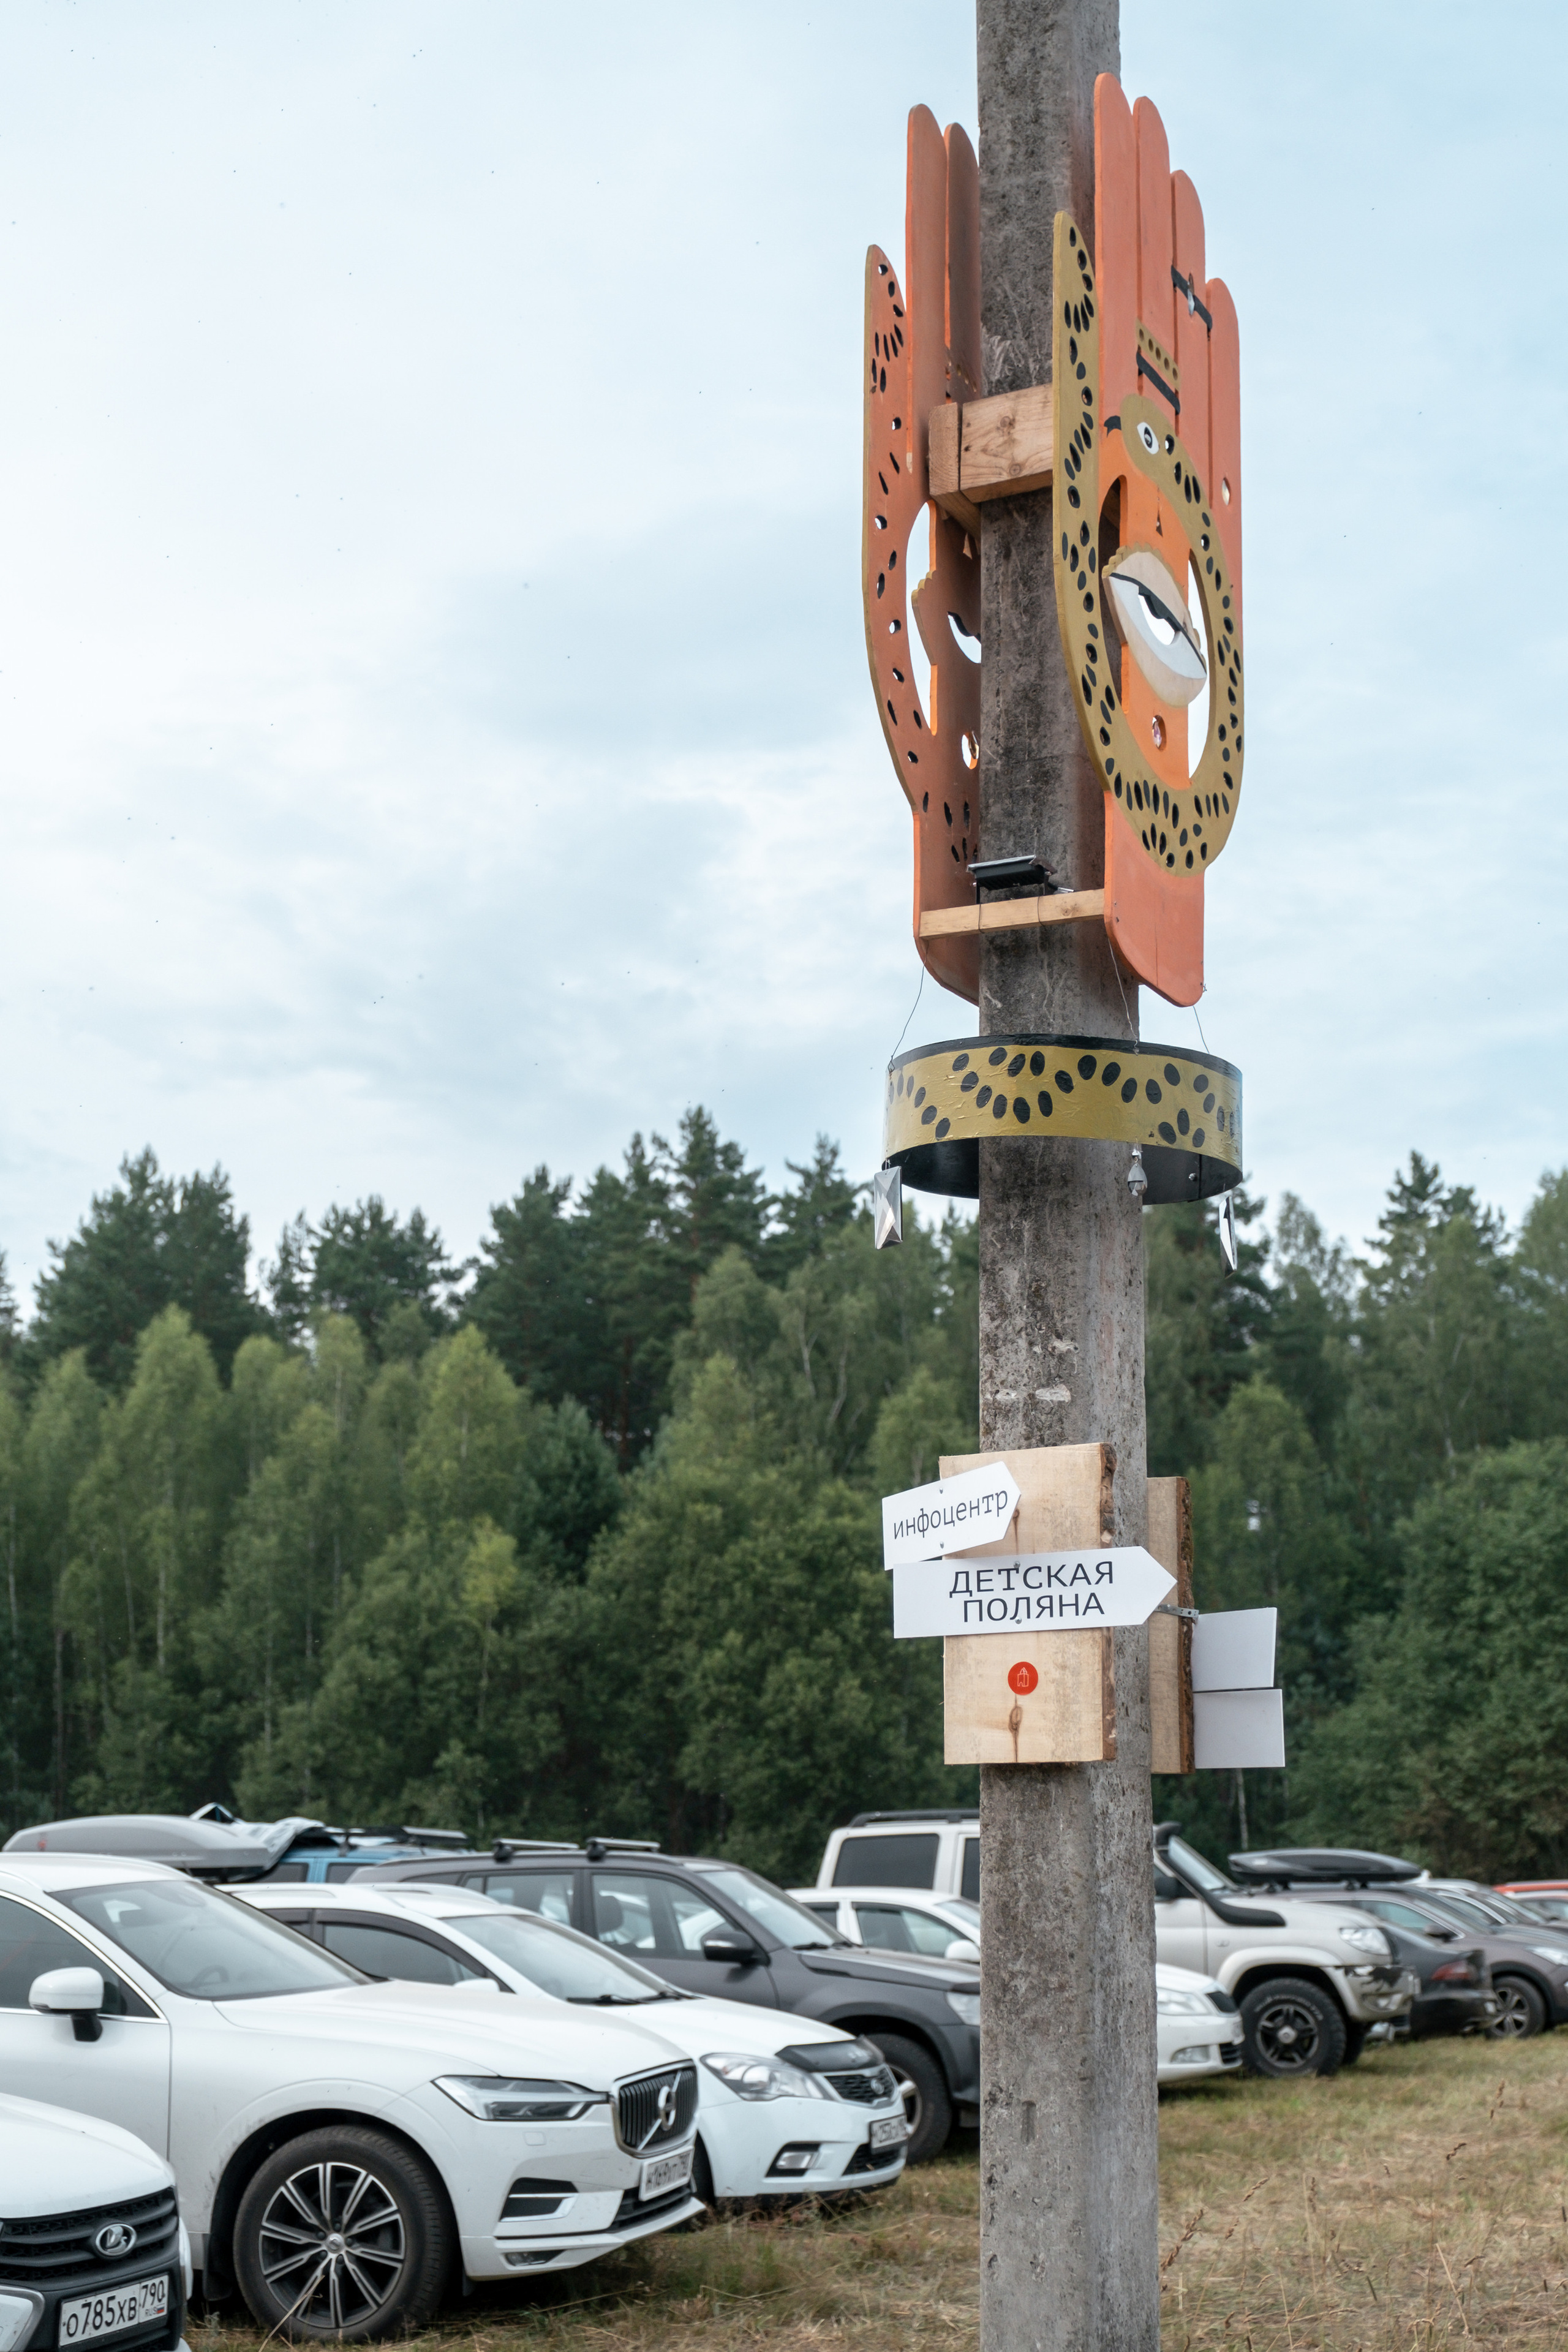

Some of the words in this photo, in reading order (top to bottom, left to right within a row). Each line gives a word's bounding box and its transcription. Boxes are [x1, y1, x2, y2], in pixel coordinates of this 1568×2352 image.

[894, 1490, 1008, 1539] инфоцентр
[949, 1561, 1113, 1598] ДЕТСКАЯ
[964, 1593, 1105, 1623] ПОЛЯНА
[141, 2280, 165, 2309] 790
